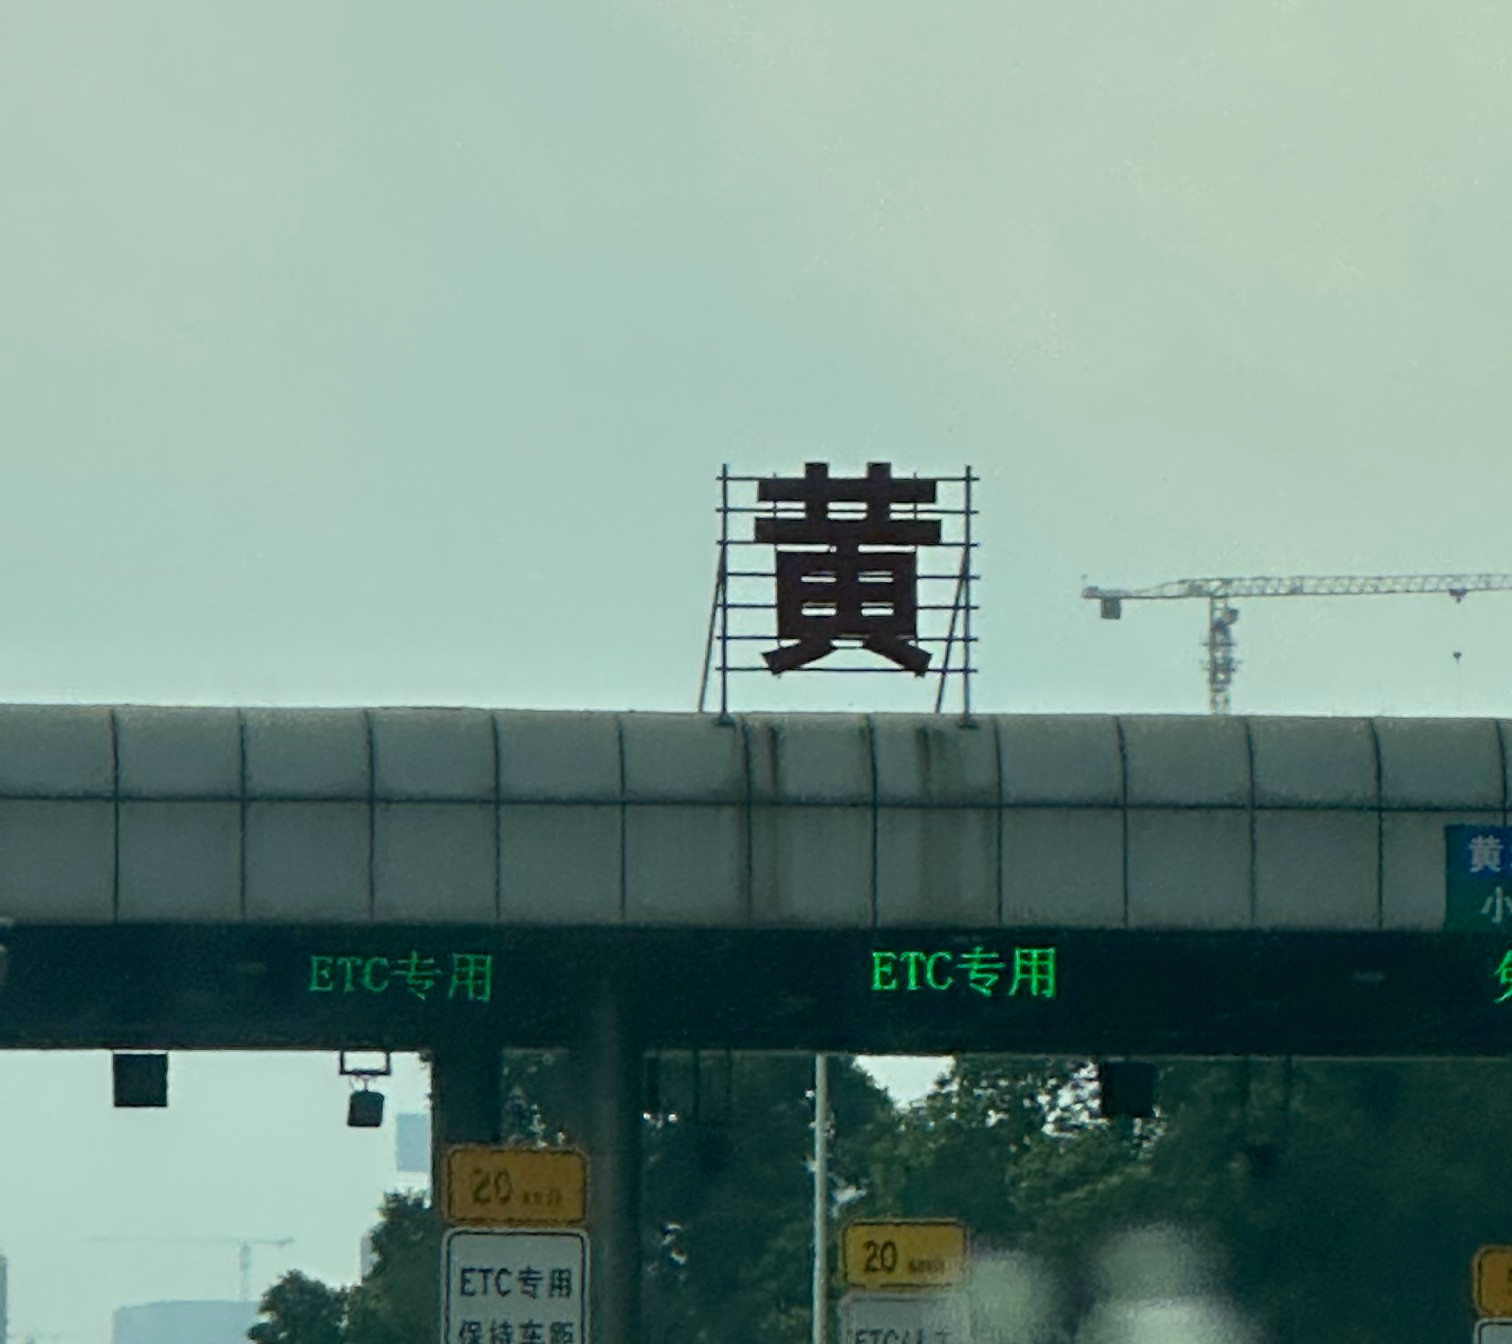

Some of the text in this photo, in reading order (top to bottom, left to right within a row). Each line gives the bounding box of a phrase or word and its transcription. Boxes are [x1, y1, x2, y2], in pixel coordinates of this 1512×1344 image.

[755, 462, 941, 677] 黄
[309, 950, 492, 1002] ETC专用
[871, 945, 1056, 997] ETC专用
[471, 1167, 513, 1204] 20
[863, 1240, 898, 1274] 20
[461, 1266, 572, 1299] ETC专用
